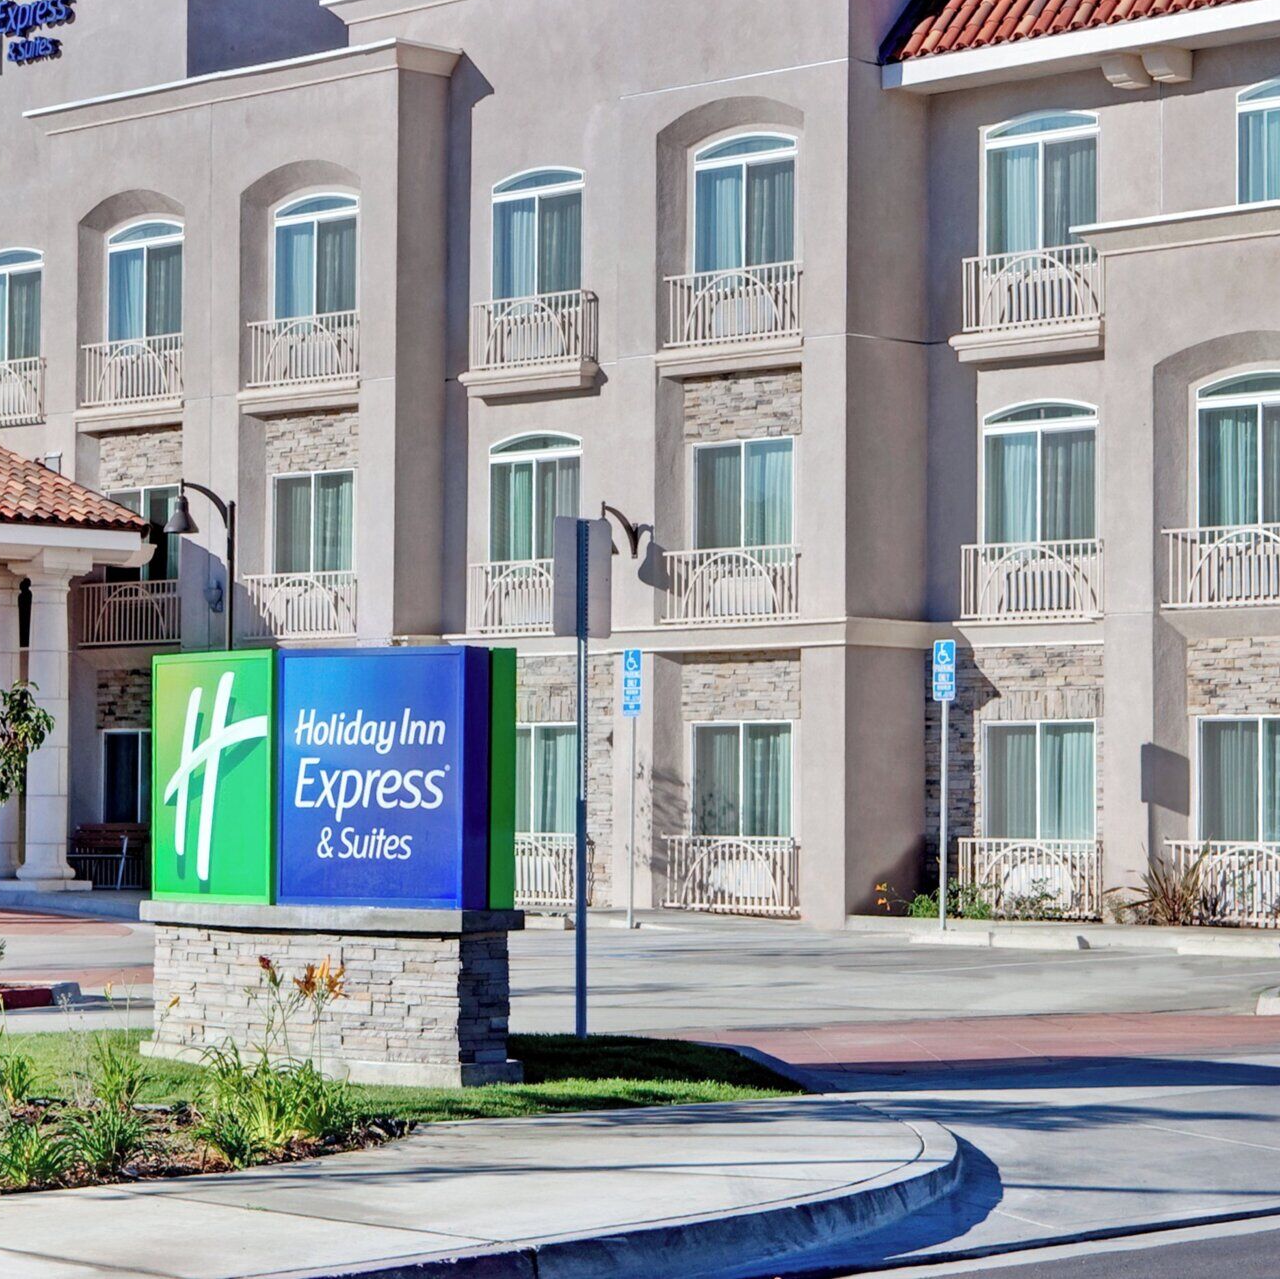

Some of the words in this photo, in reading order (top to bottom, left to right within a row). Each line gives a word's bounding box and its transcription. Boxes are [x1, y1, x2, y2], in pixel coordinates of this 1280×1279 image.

[7, 41, 16, 61] &
[17, 36, 54, 60] Suites
[294, 708, 396, 755] Holiday
[399, 707, 446, 745] Inn
[294, 757, 446, 823] Express
[317, 826, 334, 859] &
[338, 826, 413, 860] Suites
